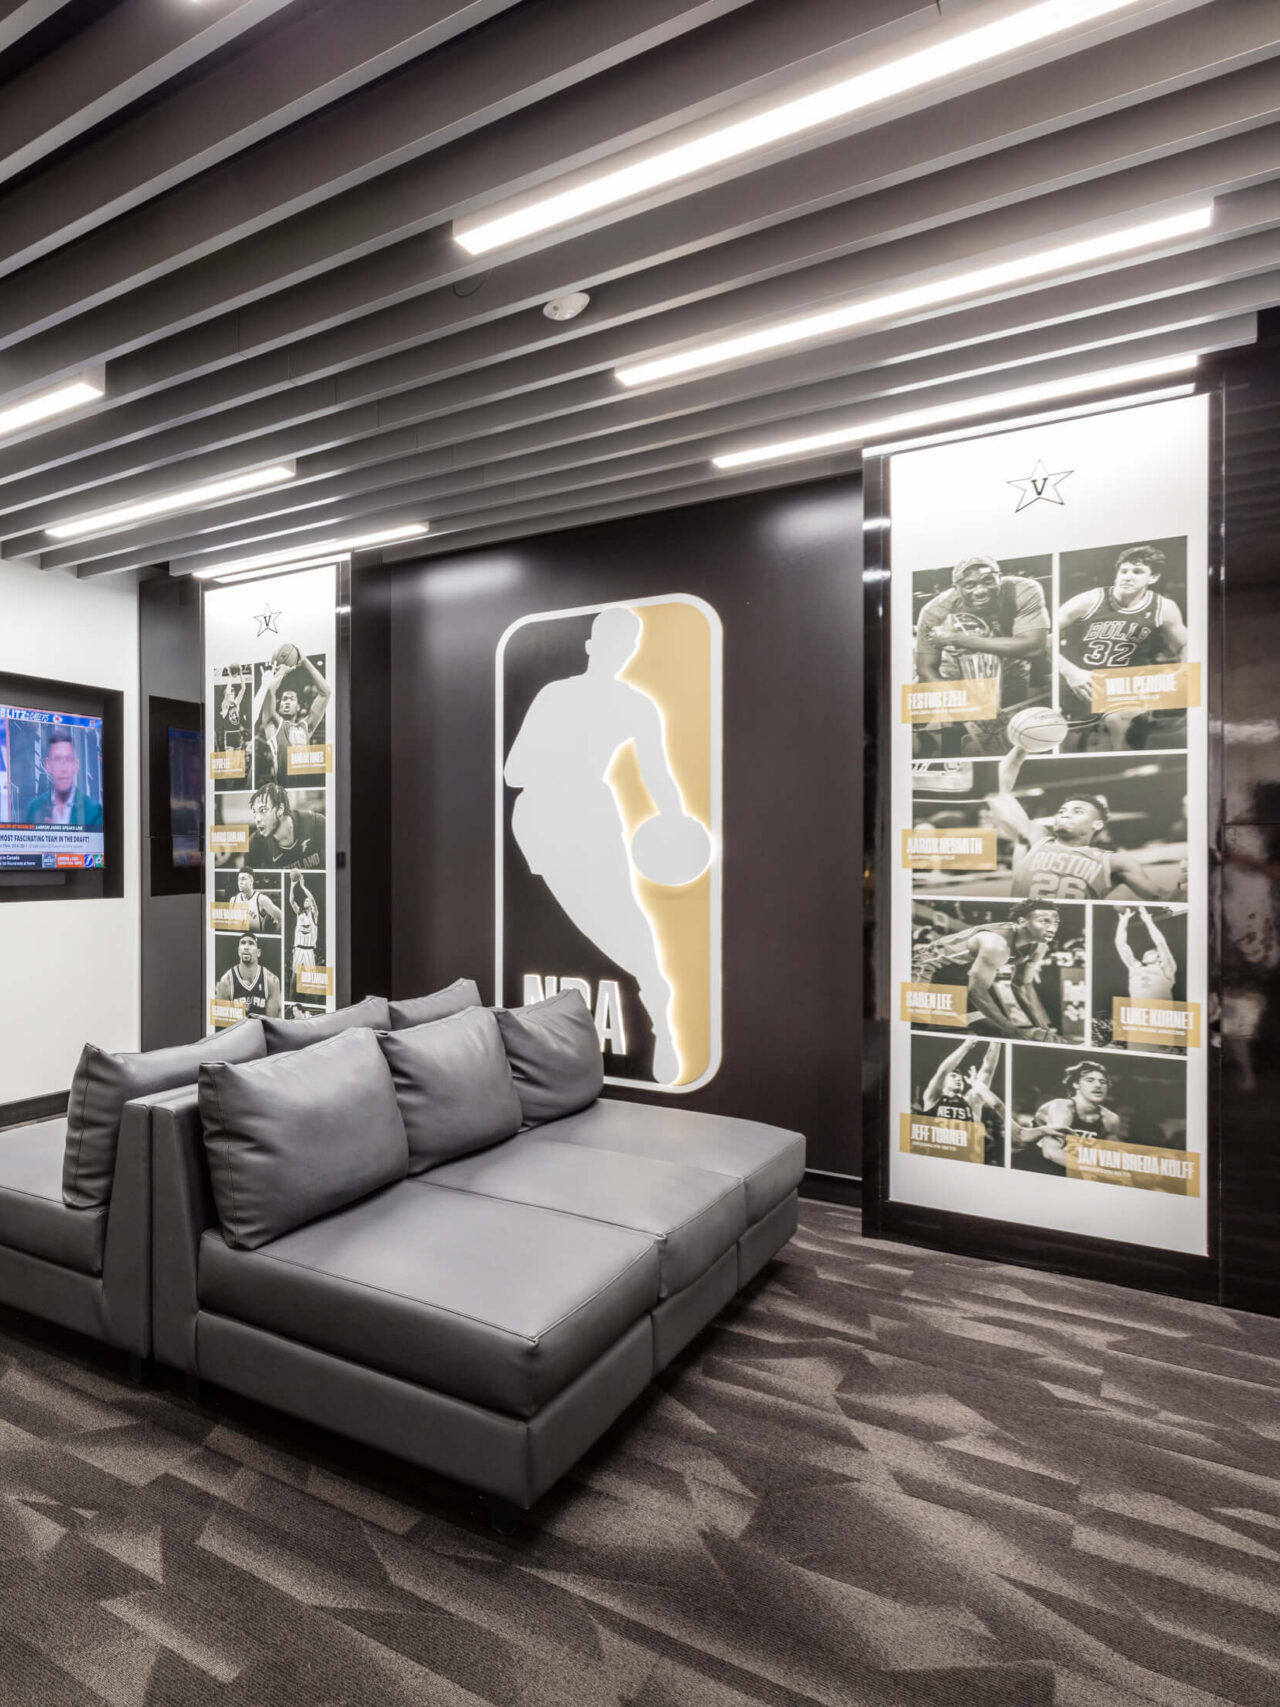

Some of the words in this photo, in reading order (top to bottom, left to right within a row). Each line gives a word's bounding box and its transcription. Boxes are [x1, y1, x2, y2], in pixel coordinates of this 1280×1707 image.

[1082, 621, 1152, 641] BULLS
[1083, 640, 1138, 667] 32
[14, 835, 45, 843] FASCINATING
[1030, 851, 1103, 884] BOSTON
[937, 993, 952, 1010] LEE
[937, 1105, 967, 1120] NETS
[911, 1123, 930, 1141] JEFF
[931, 1126, 968, 1147] TURNER
[1098, 1149, 1121, 1169] VAN
